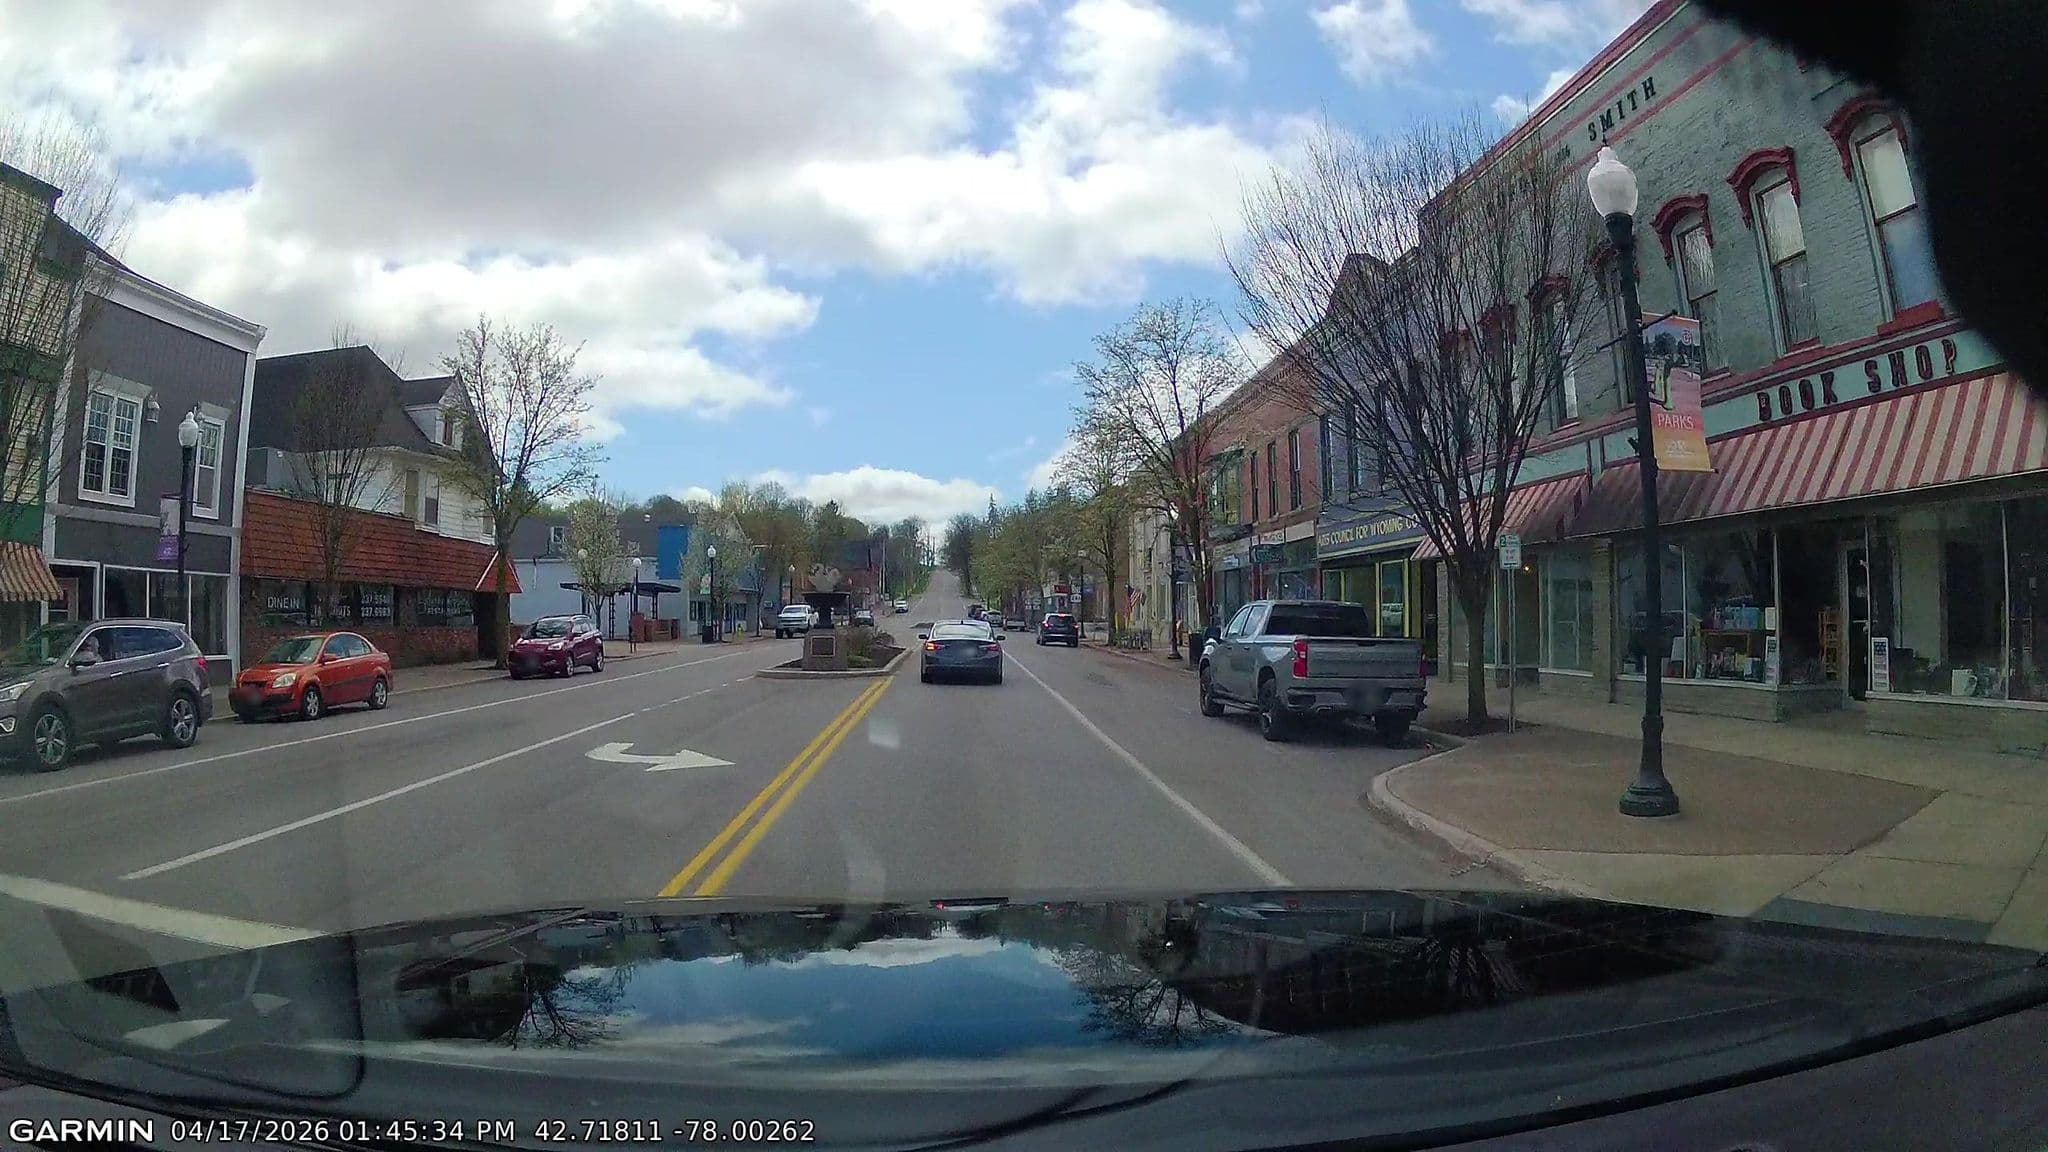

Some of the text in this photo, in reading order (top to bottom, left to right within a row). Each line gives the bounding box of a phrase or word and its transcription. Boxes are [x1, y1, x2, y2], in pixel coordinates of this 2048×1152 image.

[1588, 76, 1656, 141] SMITH
[1757, 338, 1957, 422] BOOK SHOP
[1657, 413, 1694, 430] PARKS
[1331, 527, 1354, 545] COUNCIL
[1355, 524, 1368, 539] FOR
[1370, 516, 1403, 536] WYOMING
[267, 597, 299, 609] DINE IN
